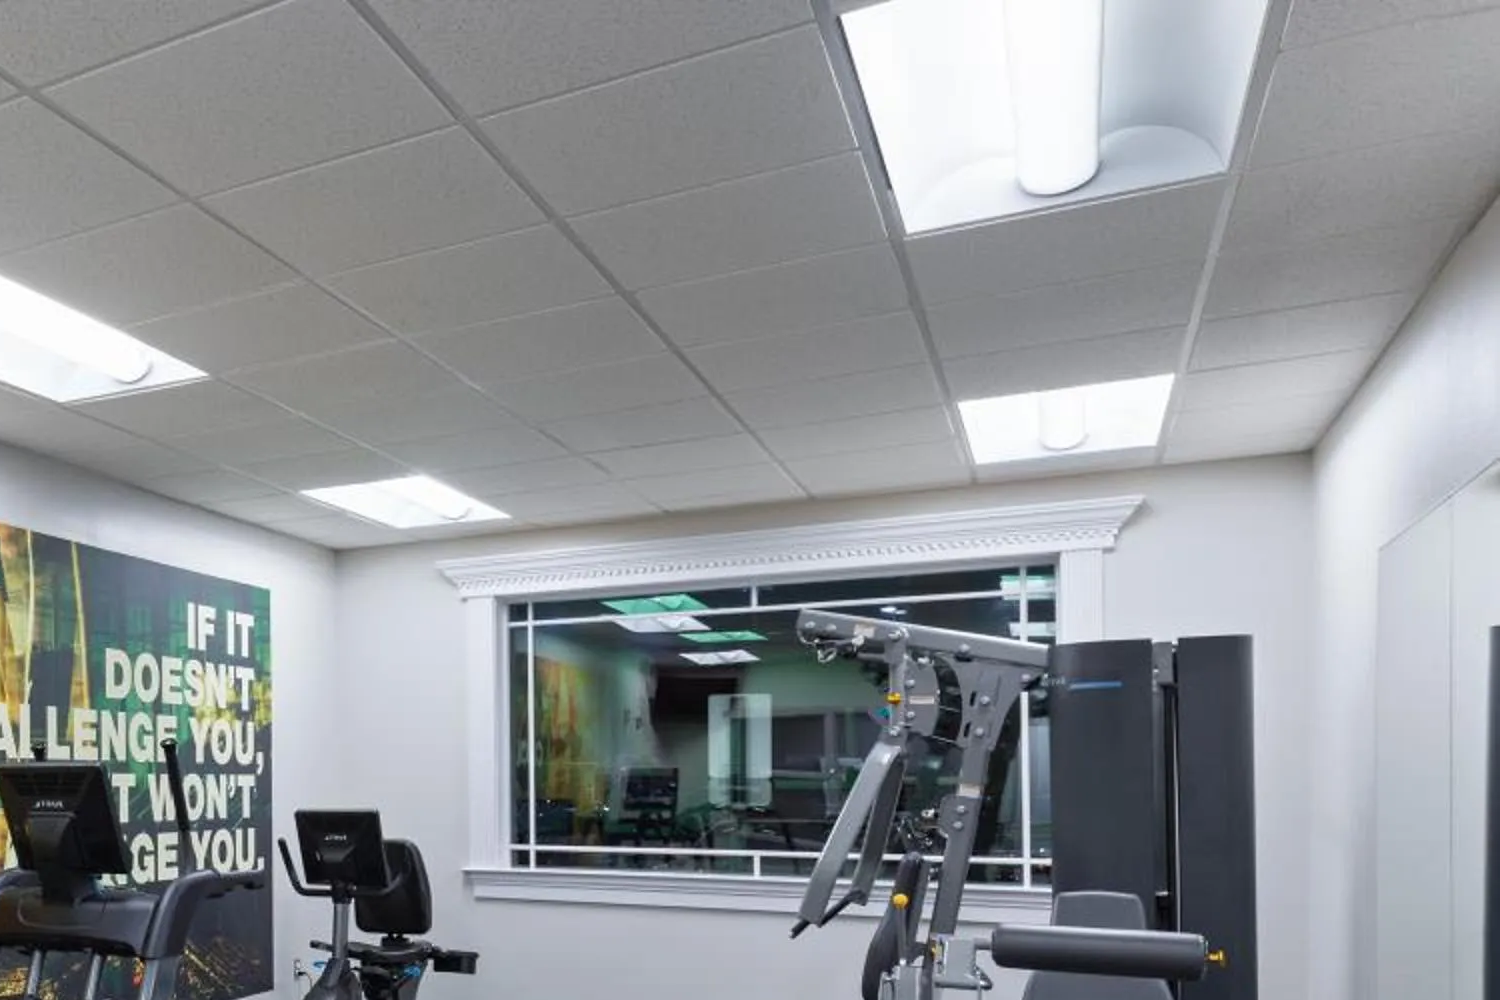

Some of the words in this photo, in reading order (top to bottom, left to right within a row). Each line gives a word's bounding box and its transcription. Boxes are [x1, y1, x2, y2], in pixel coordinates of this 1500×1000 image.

[187, 602, 217, 651] IF
[226, 610, 255, 658] IT
[104, 647, 255, 711] DOESN'T
[189, 716, 264, 775] YOU,
[110, 773, 137, 824] T
[147, 772, 256, 823] WON'T
[189, 827, 265, 874] YOU.
